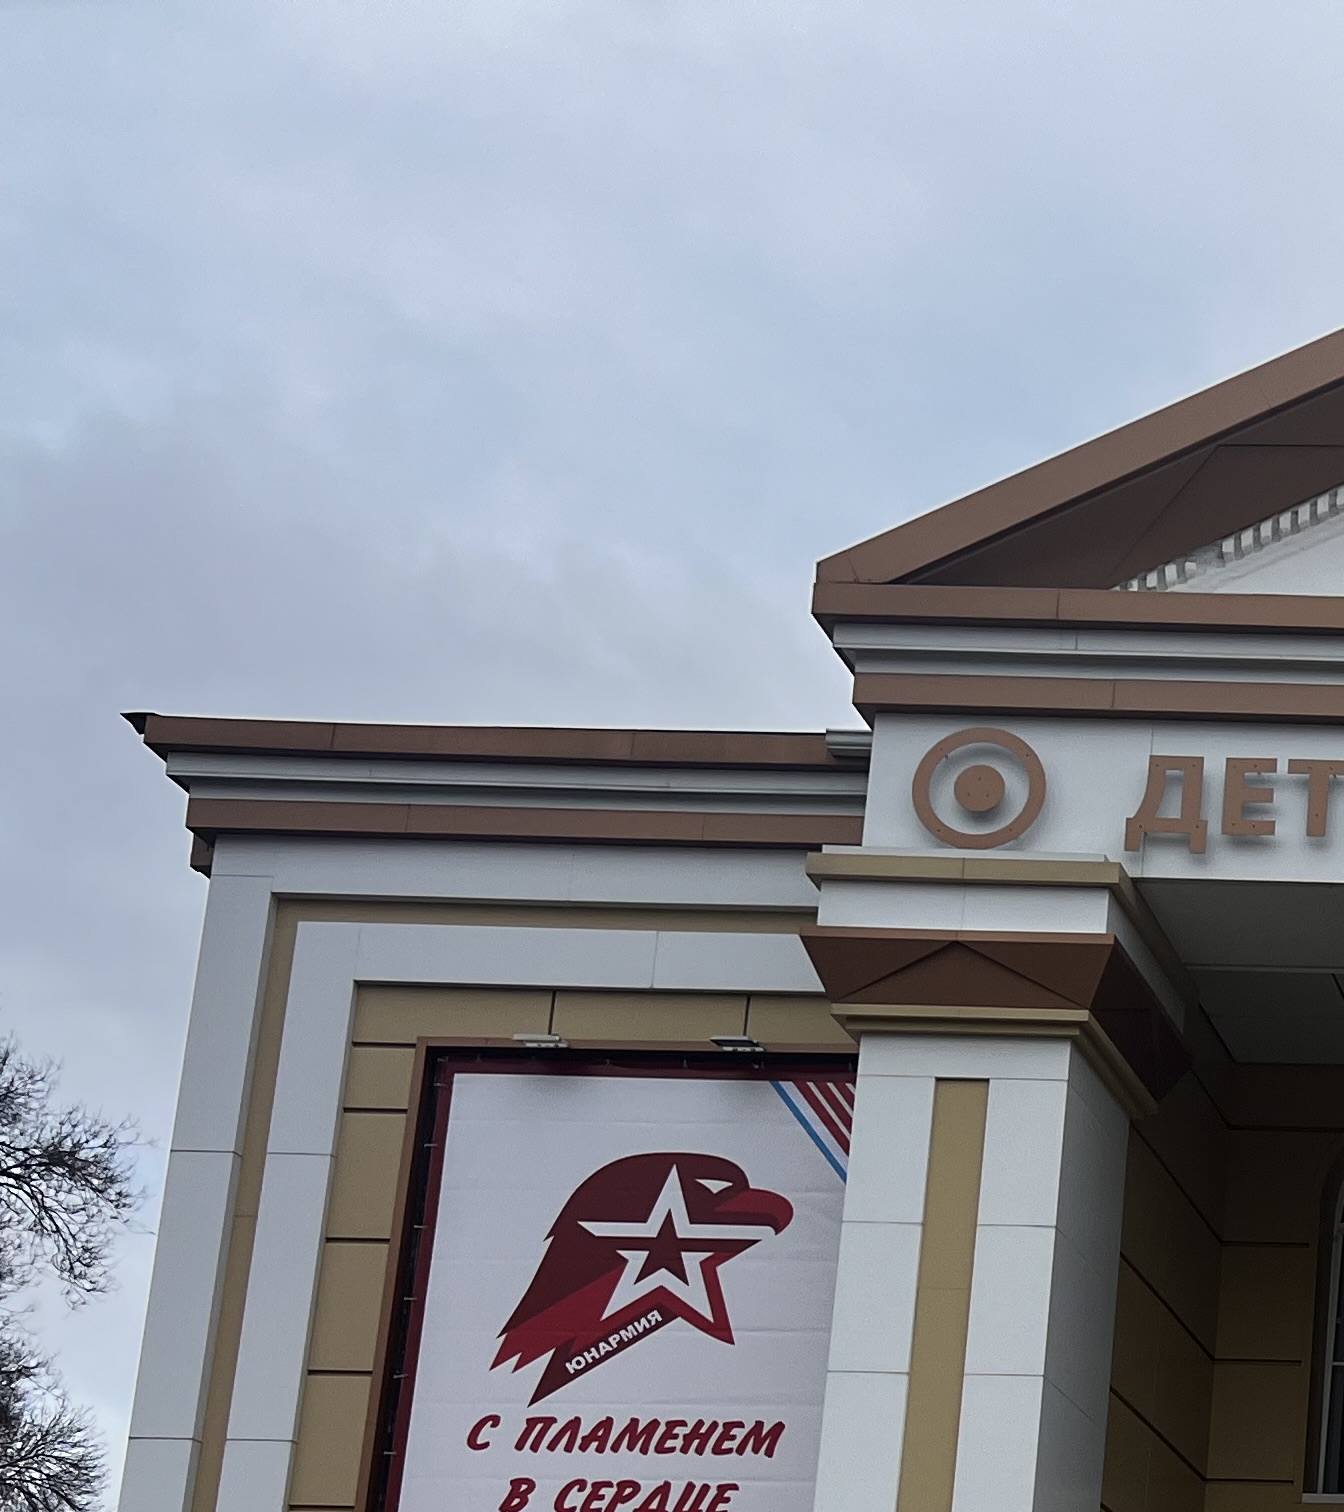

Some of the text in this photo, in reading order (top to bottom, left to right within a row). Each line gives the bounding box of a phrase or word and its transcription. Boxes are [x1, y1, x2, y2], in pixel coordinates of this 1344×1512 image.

[565, 1309, 663, 1374] ЮНАРМИЯ
[466, 1414, 786, 1458] С ПЛАМЕНЕМ
